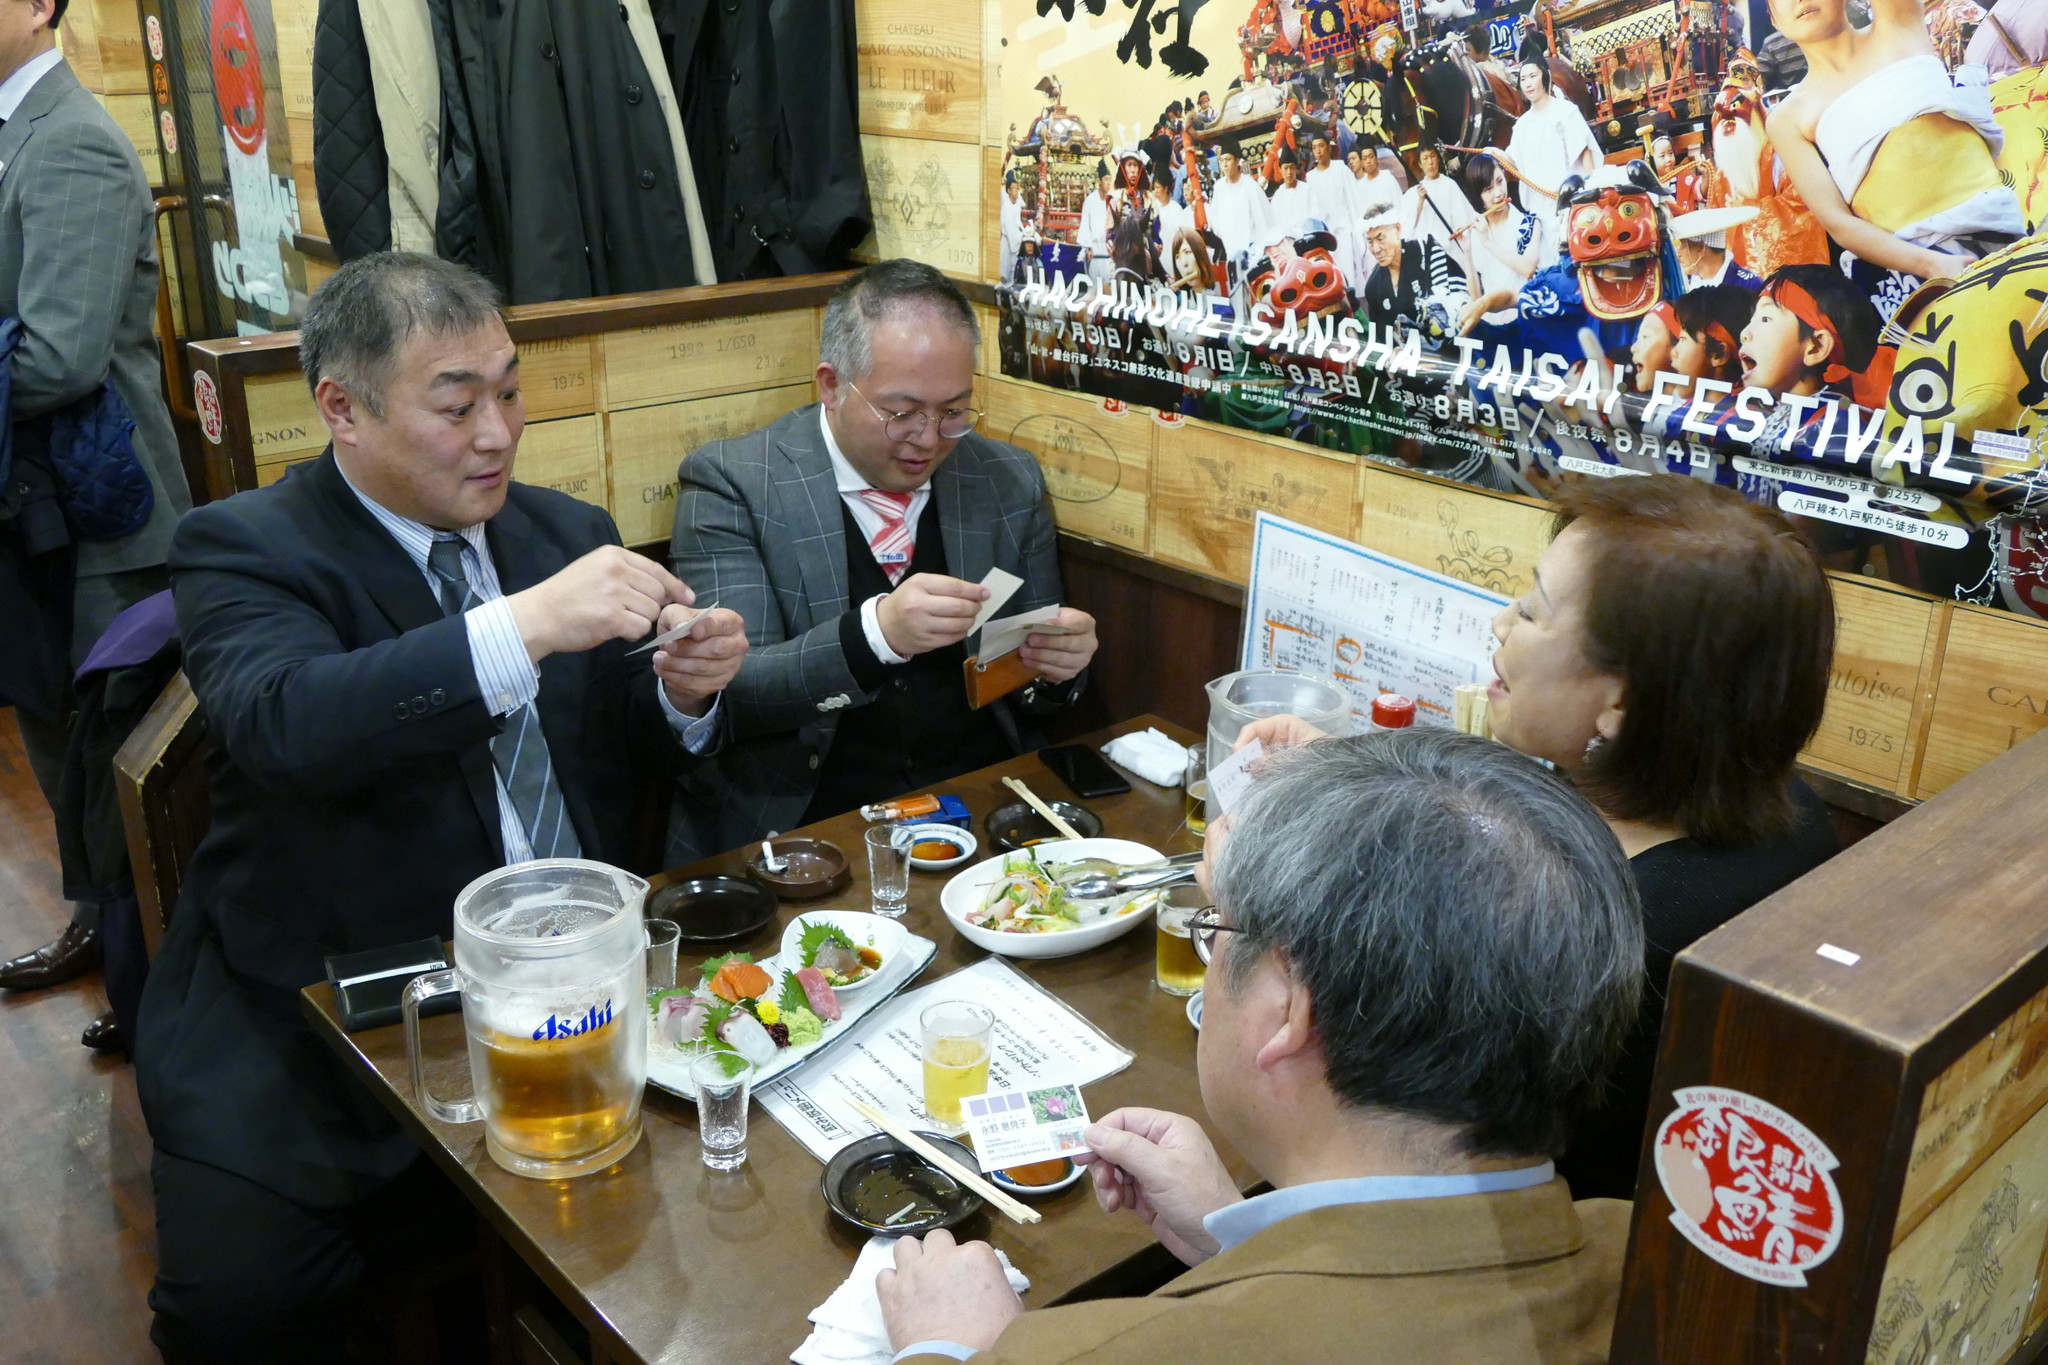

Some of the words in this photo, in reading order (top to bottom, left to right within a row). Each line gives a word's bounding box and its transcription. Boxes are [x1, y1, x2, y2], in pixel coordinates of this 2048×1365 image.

[887, 23, 935, 35] CHATEAU
[858, 43, 967, 60] CARCASSONNE
[868, 65, 887, 89] LE
[902, 67, 957, 94] FLEUR
[947, 248, 975, 266] 1970
[716, 333, 756, 352] 1/650
[553, 372, 586, 391] 1975
[1019, 265, 1230, 338] HACHINOHE
[1242, 302, 1423, 378] SANSHA
[1452, 335, 1625, 416] TAISAI
[1641, 369, 1974, 486] FESTIVAL
[1054, 318, 1122, 349] 7月31日
[1176, 341, 1235, 372] 8月1日
[1259, 361, 1285, 378] 中日
[1287, 363, 1362, 399] 8月2日
[1434, 394, 1521, 432] 8月3日
[1555, 418, 1607, 444] 後夜祭
[1613, 427, 1712, 470] 8月4日
[1485, 434, 1553, 457] TEL.0178-46-4040
[1978, 431, 2029, 448] 北海道新幹線
[1566, 457, 1617, 476] 八戸三社大祭
[1793, 497, 1950, 543] 八戸線本八戸駅から徒歩10分
[1847, 725, 1894, 753] 1975
[532, 998, 613, 1042] Asahi
[775, 1080, 838, 1133] 飲み放題メニュー
